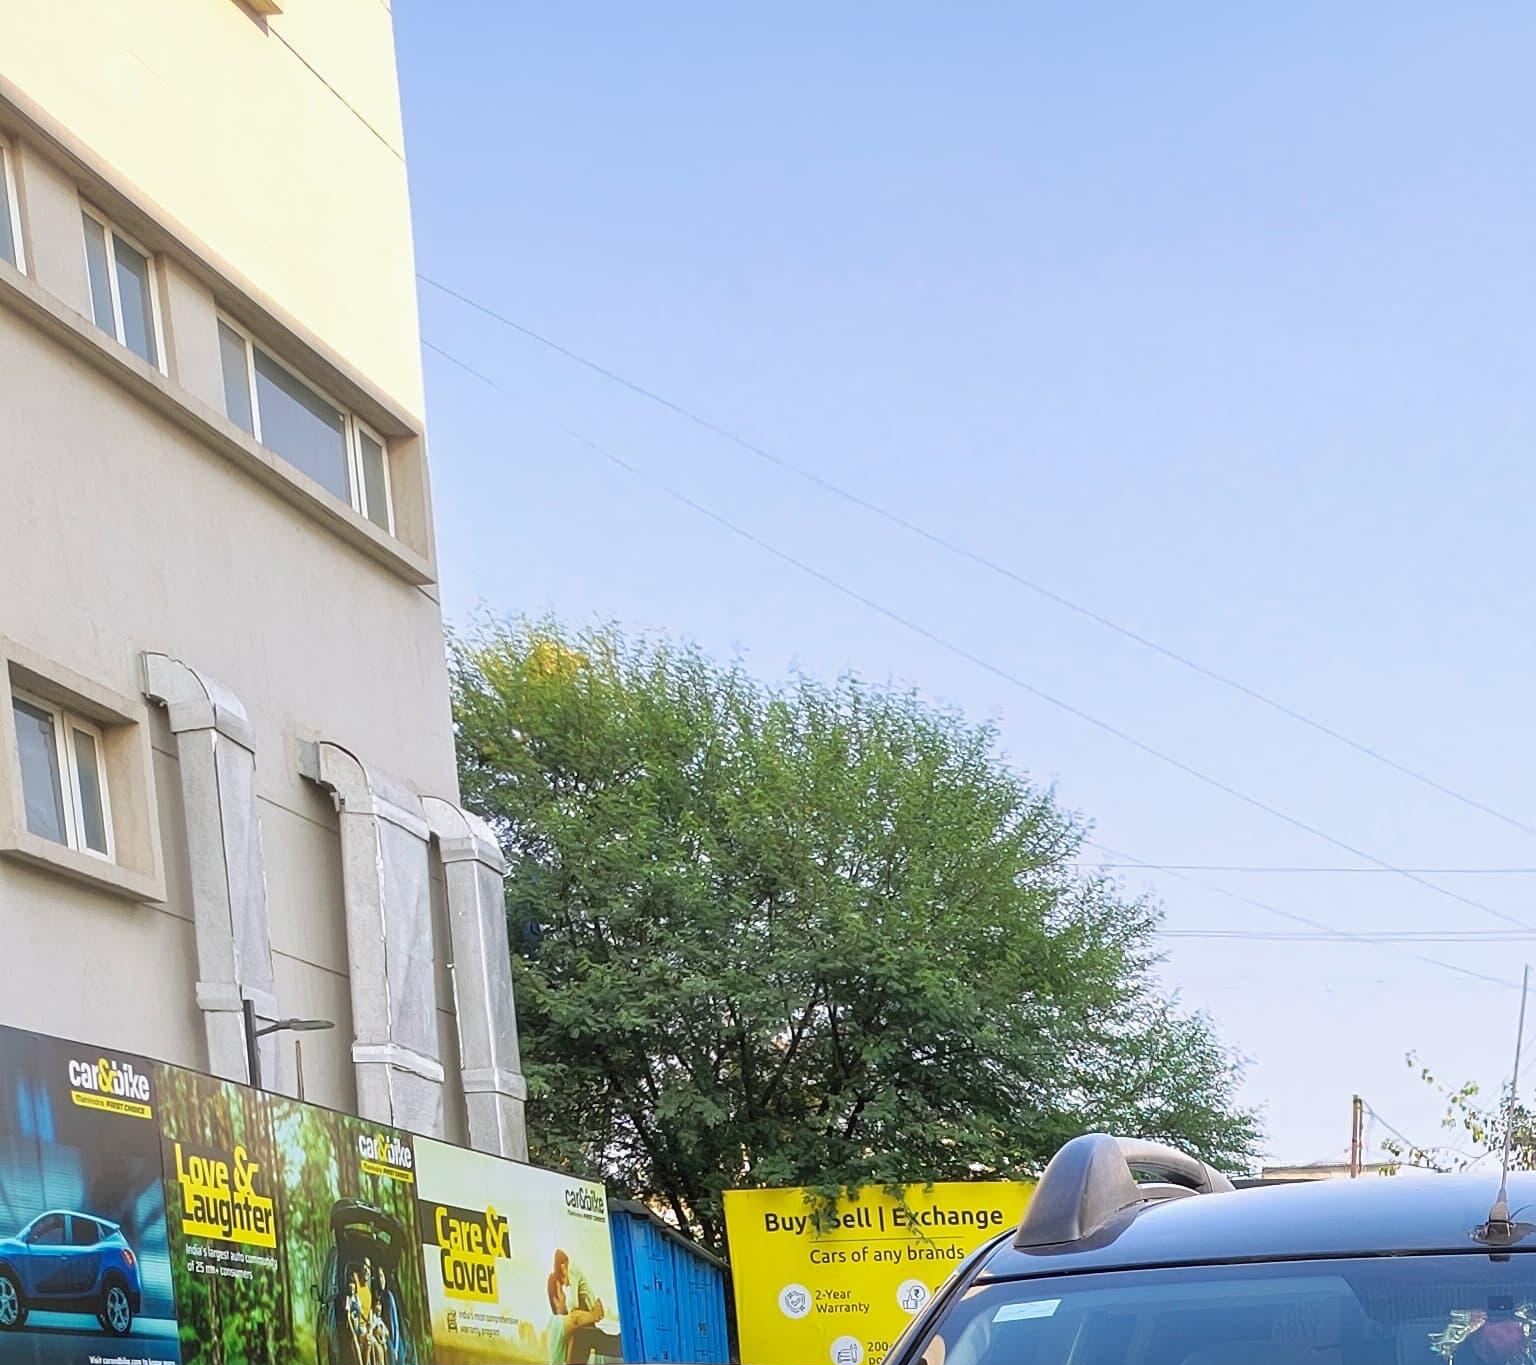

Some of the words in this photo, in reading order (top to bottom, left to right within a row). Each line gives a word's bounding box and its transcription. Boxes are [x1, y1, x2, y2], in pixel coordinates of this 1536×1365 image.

[68, 1058, 150, 1101] car&bike
[359, 1134, 412, 1168] car&bike
[175, 1143, 229, 1189] Love
[234, 1146, 260, 1196] &
[182, 1182, 272, 1237] Laughter
[565, 1187, 604, 1214] car&bike
[436, 1207, 482, 1253] Care
[485, 1205, 508, 1258] &
[765, 1213, 807, 1235] Buy
[893, 1206, 1003, 1228] Exchange
[810, 1249, 846, 1264] Cars
[851, 1246, 869, 1262] of
[874, 1249, 902, 1265] any
[908, 1244, 965, 1260] brands
[441, 1248, 495, 1294] Cover
[815, 1290, 851, 1300] 2-Year
[816, 1302, 870, 1314] Warranty
[867, 1342, 893, 1353] 200
